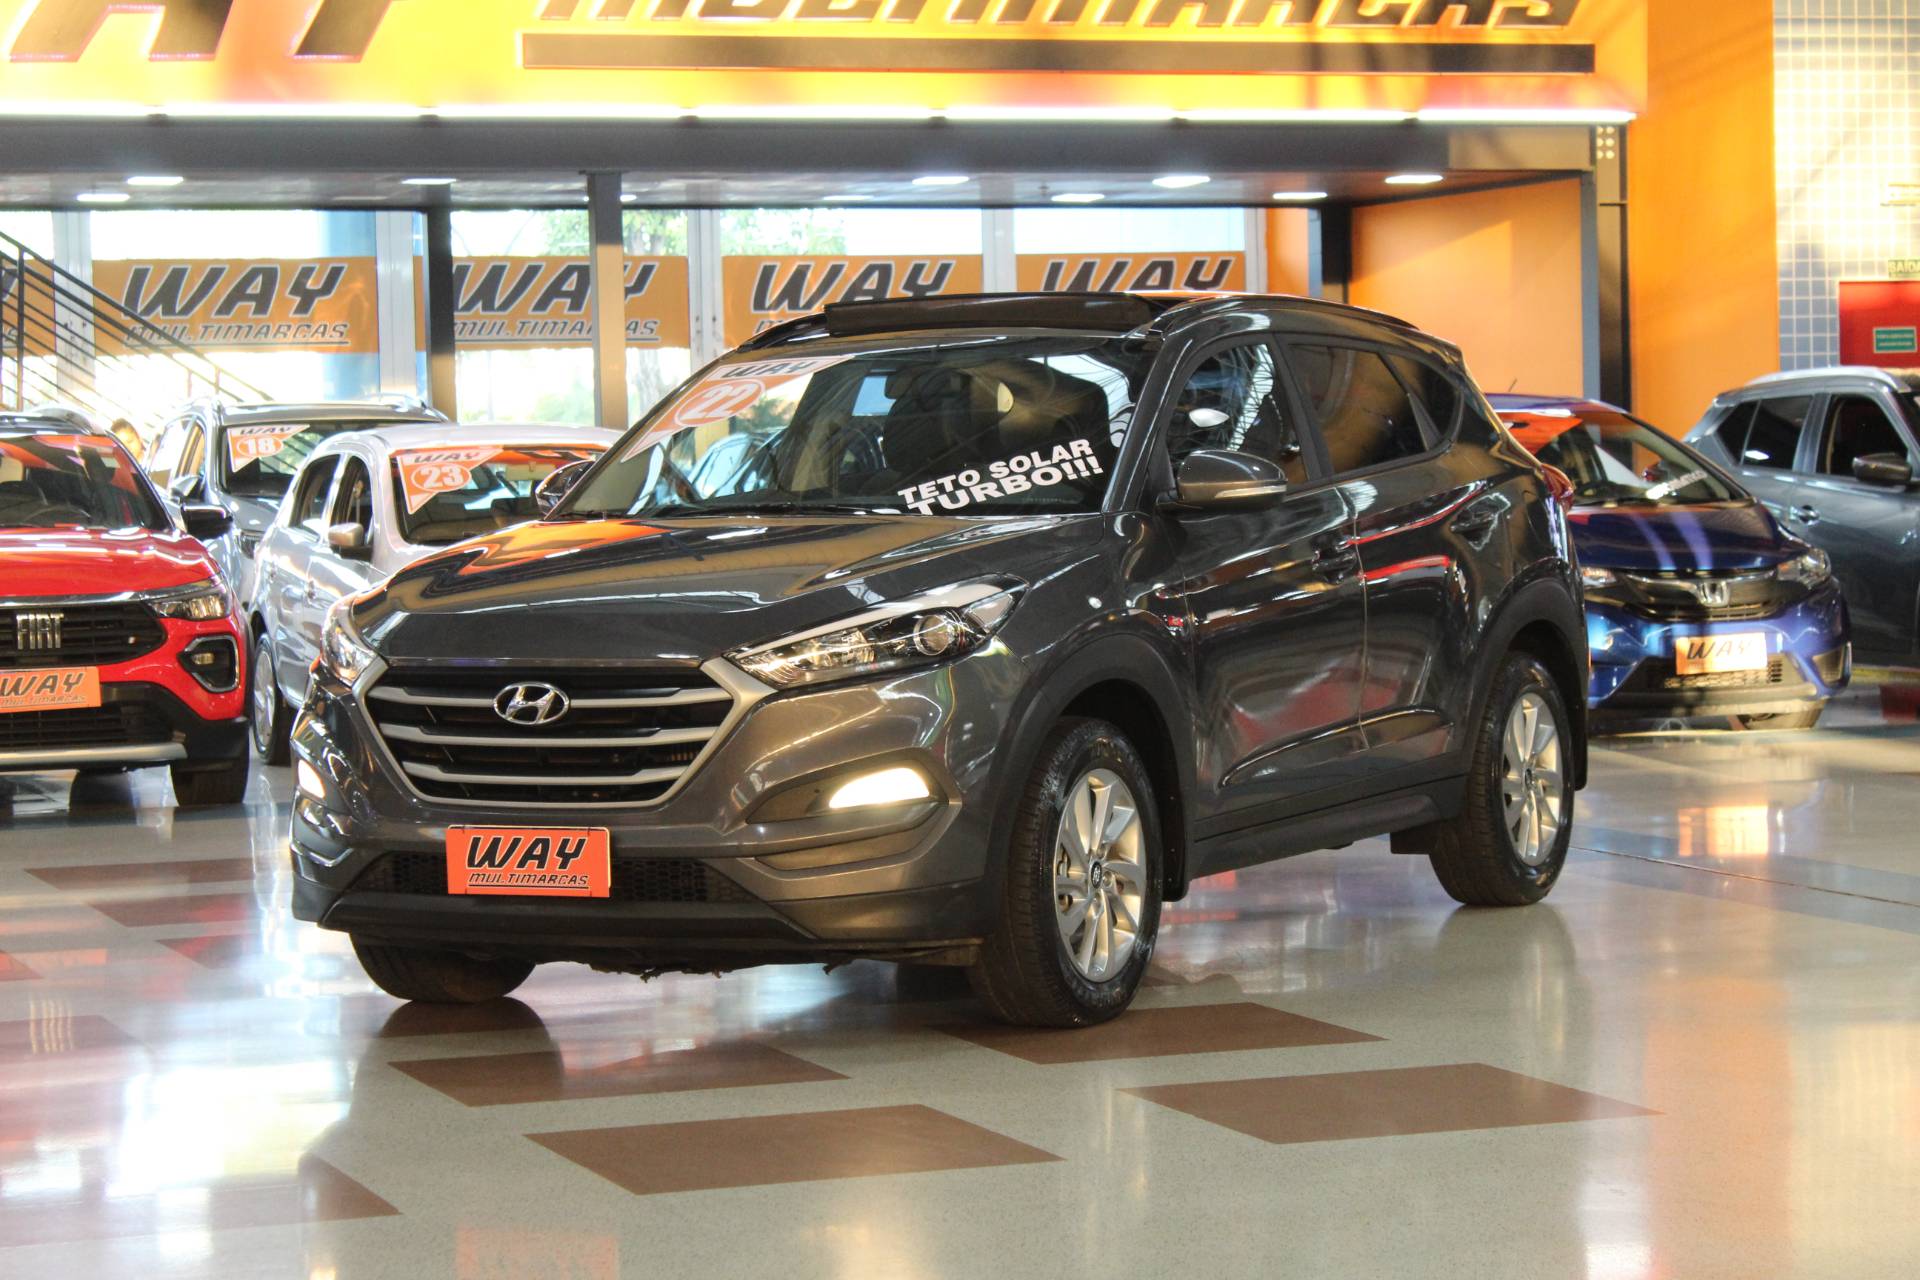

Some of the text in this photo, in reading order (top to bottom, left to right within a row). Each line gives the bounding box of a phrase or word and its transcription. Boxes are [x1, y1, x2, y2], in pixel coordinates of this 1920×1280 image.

[121, 263, 348, 319] WAY
[752, 260, 956, 313] WAY
[719, 360, 816, 378] WAY
[678, 382, 757, 421] 22
[242, 437, 276, 454] 18
[414, 450, 481, 464] WAY
[420, 466, 466, 488] 23
[897, 439, 1093, 504] TETO SOLAR
[907, 455, 1104, 516] TURBO!!!
[0, 672, 85, 697] WAY
[466, 836, 587, 870] WAY
[469, 872, 588, 885] MULTIMARCAS
